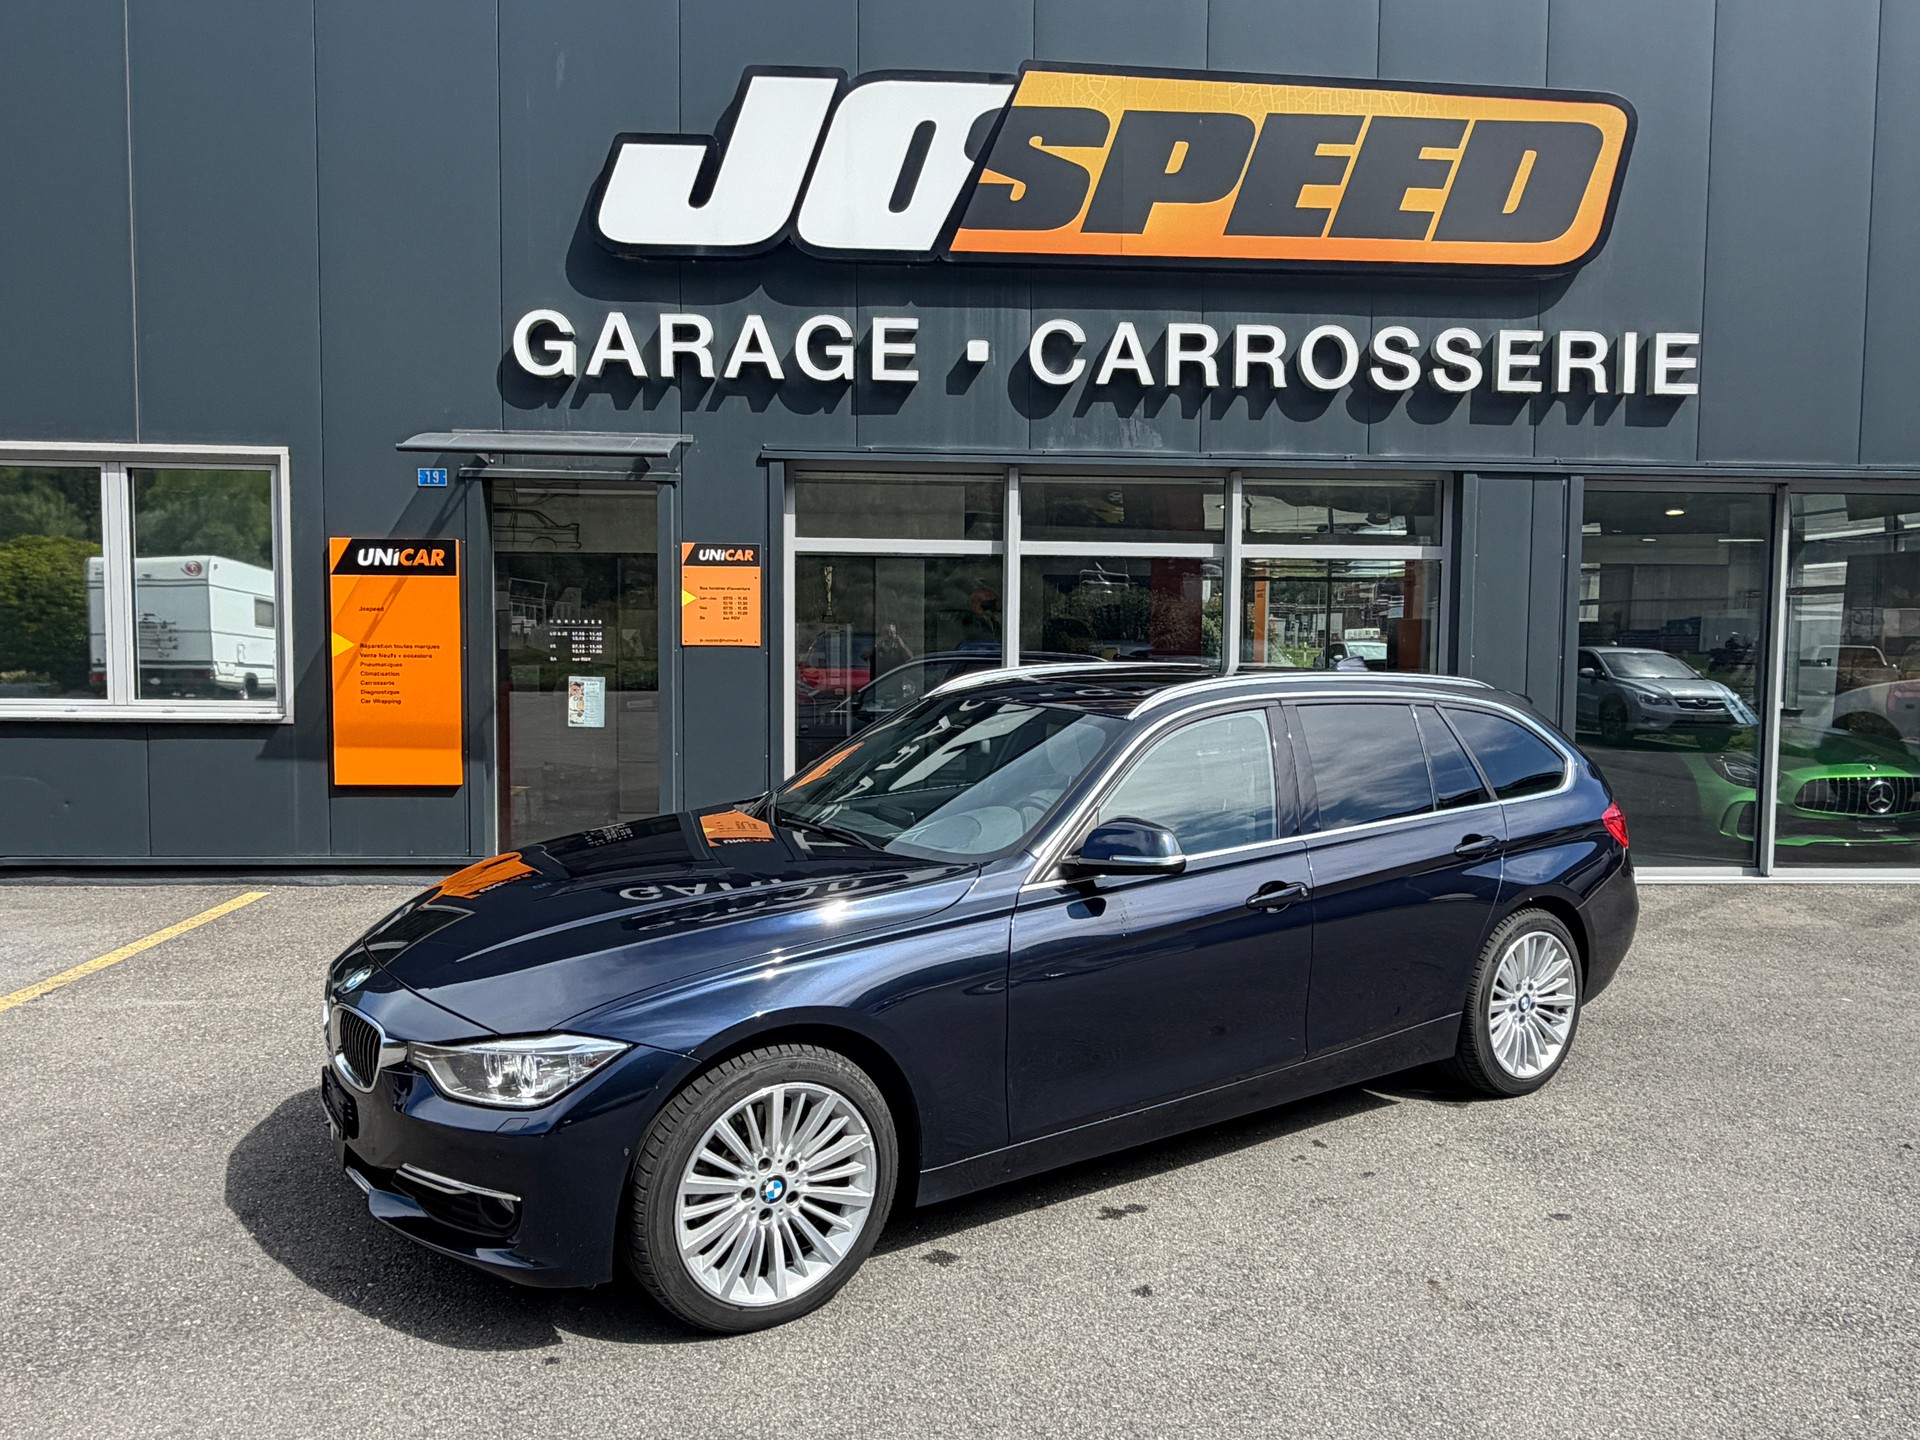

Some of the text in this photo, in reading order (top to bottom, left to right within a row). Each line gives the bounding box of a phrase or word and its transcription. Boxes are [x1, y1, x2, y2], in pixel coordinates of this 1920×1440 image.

[512, 309, 1700, 396] GARAGE CARROSSERIE
[425, 470, 440, 484] 19
